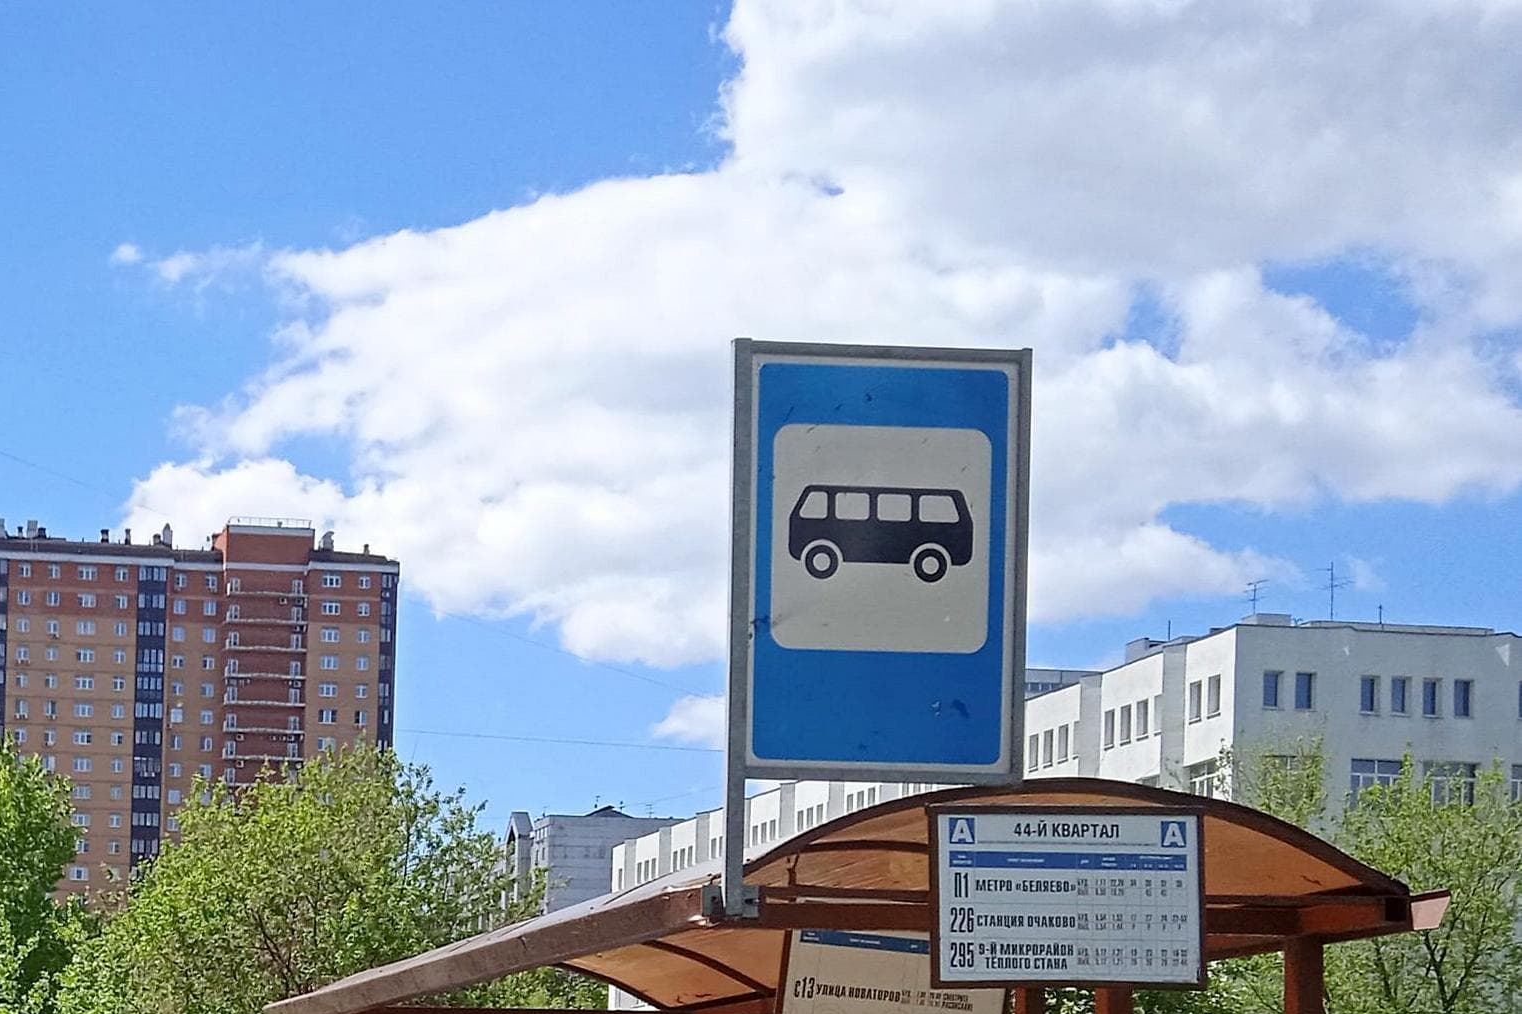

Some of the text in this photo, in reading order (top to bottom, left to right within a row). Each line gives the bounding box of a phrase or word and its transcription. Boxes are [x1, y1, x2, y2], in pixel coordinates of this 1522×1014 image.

[1013, 820, 1119, 839] 44-Й КВАРТАЛ
[954, 872, 969, 898] П1
[976, 880, 1012, 892] МЕТРО
[1016, 880, 1076, 893] «БЕЛЯЕВО»
[950, 907, 974, 933] 226
[977, 915, 1024, 928] СТАНЦИЯ
[1027, 916, 1076, 928] ОЧАКОВО
[950, 942, 974, 968] 295
[979, 941, 997, 955] 9-Й
[1000, 943, 1074, 956] МИКРОРАЙОН
[1034, 958, 1068, 970] СТАНА
[816, 983, 846, 998] УЛИЦА
[848, 986, 901, 1003] НОВАТОРОВ
